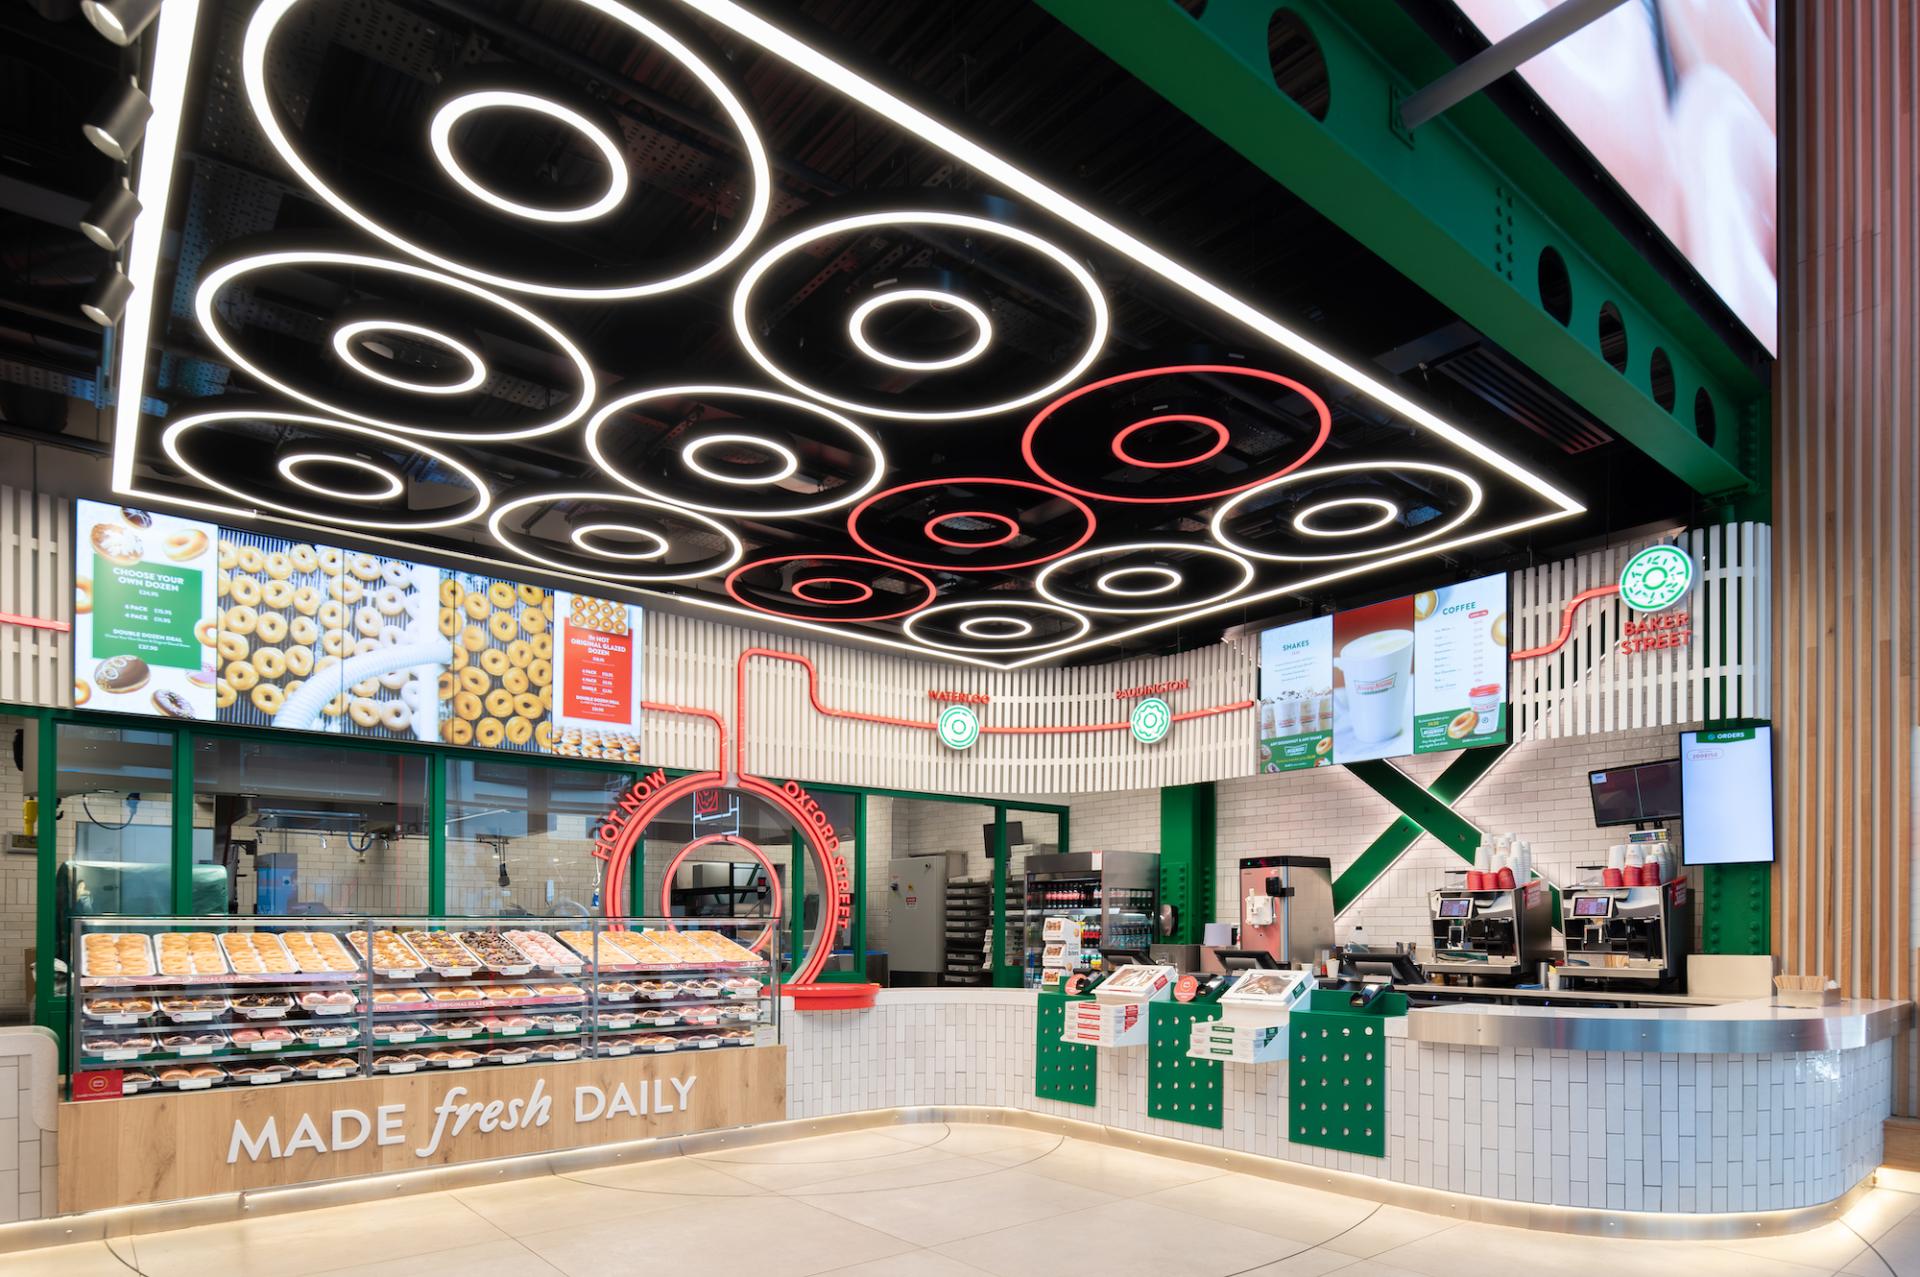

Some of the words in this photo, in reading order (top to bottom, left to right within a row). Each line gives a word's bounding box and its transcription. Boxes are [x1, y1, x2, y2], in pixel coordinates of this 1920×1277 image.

[113, 568, 155, 580] CHOOSE
[157, 575, 184, 584] YOUR
[119, 577, 143, 586] OWN
[145, 581, 179, 591] DOZEN
[1442, 601, 1476, 615] COFFEE
[1623, 612, 1690, 637] BAKER
[113, 629, 140, 637] DOUBLE
[571, 639, 602, 648] ORIGINAL
[602, 644, 626, 652] GLAZED
[1282, 639, 1310, 651] SHAKES
[1621, 630, 1693, 656] STREET
[928, 689, 990, 705] WATERLOO
[1115, 678, 1190, 700] PADDINGTON
[592, 810, 627, 862] HOT
[619, 767, 667, 816] NOW
[784, 780, 840, 852] OXFORD
[833, 855, 851, 929] STREET
[226, 1104, 406, 1164] MADE
[415, 1078, 552, 1158] fresh
[575, 1075, 697, 1124] DAILY
